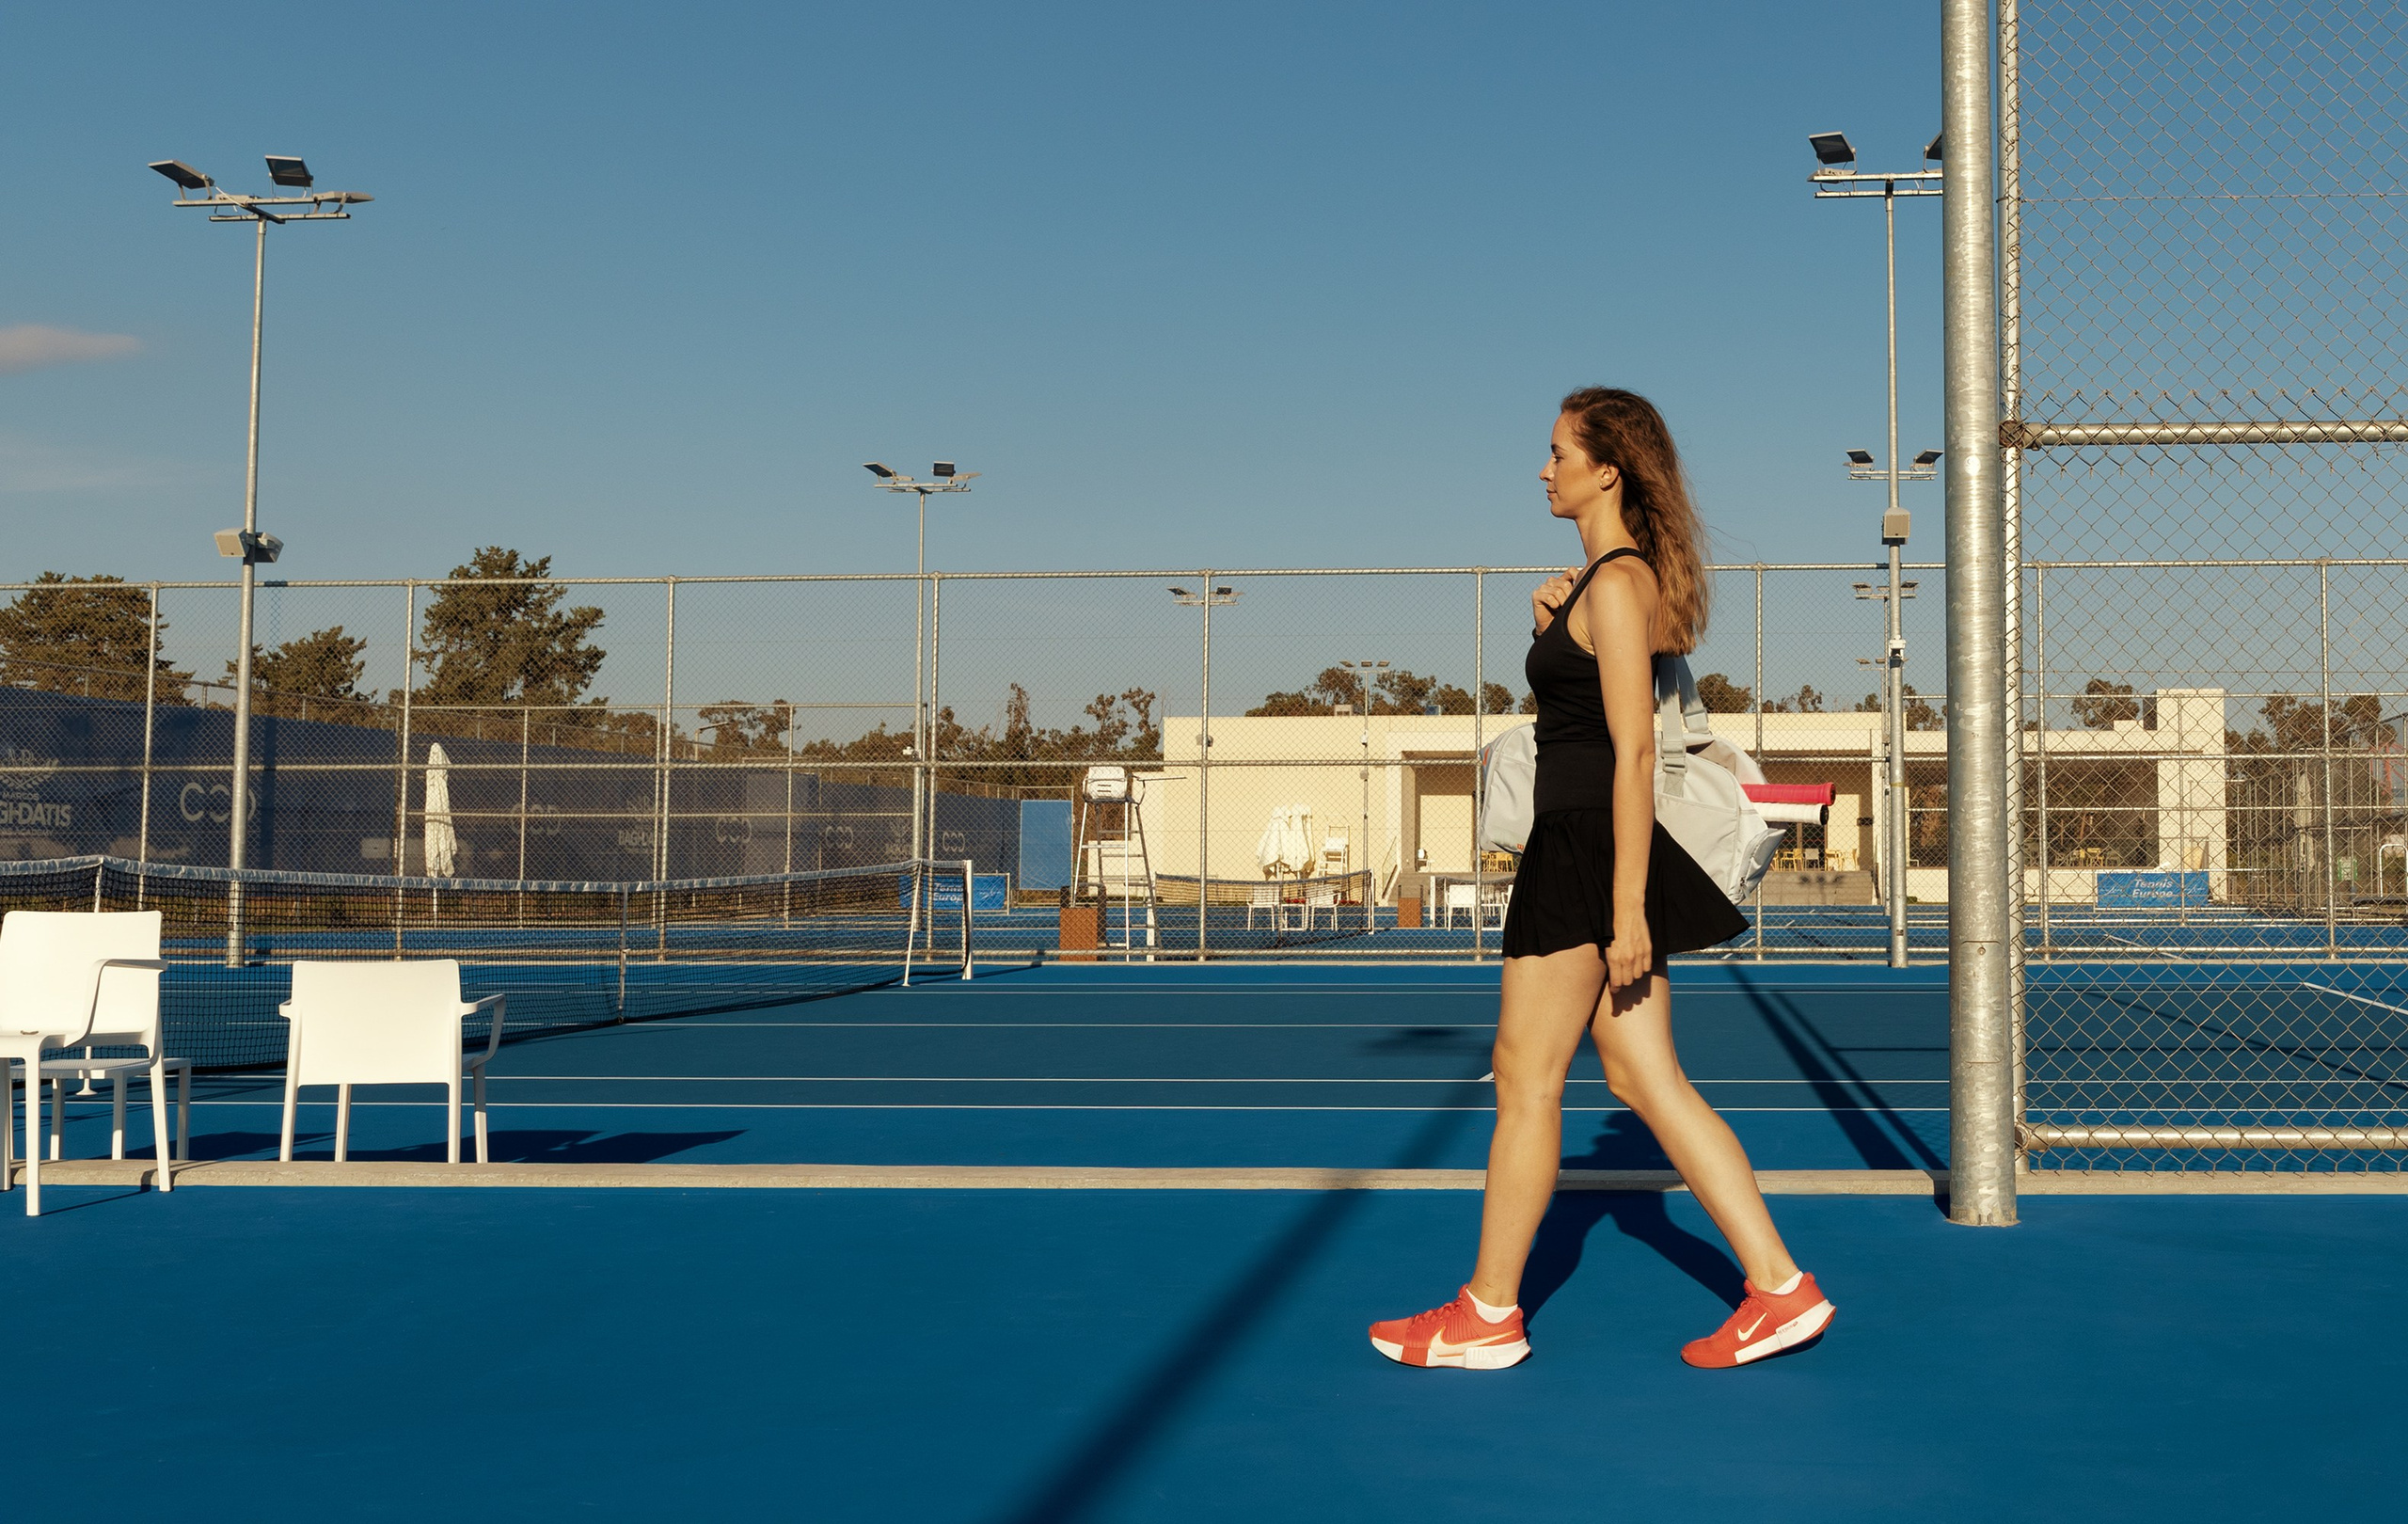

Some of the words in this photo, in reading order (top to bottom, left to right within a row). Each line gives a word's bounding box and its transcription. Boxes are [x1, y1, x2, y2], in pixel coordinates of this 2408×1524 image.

[2133, 879, 2174, 889] Tennis
[933, 893, 964, 903] Europ
[2131, 888, 2174, 898] Europe
